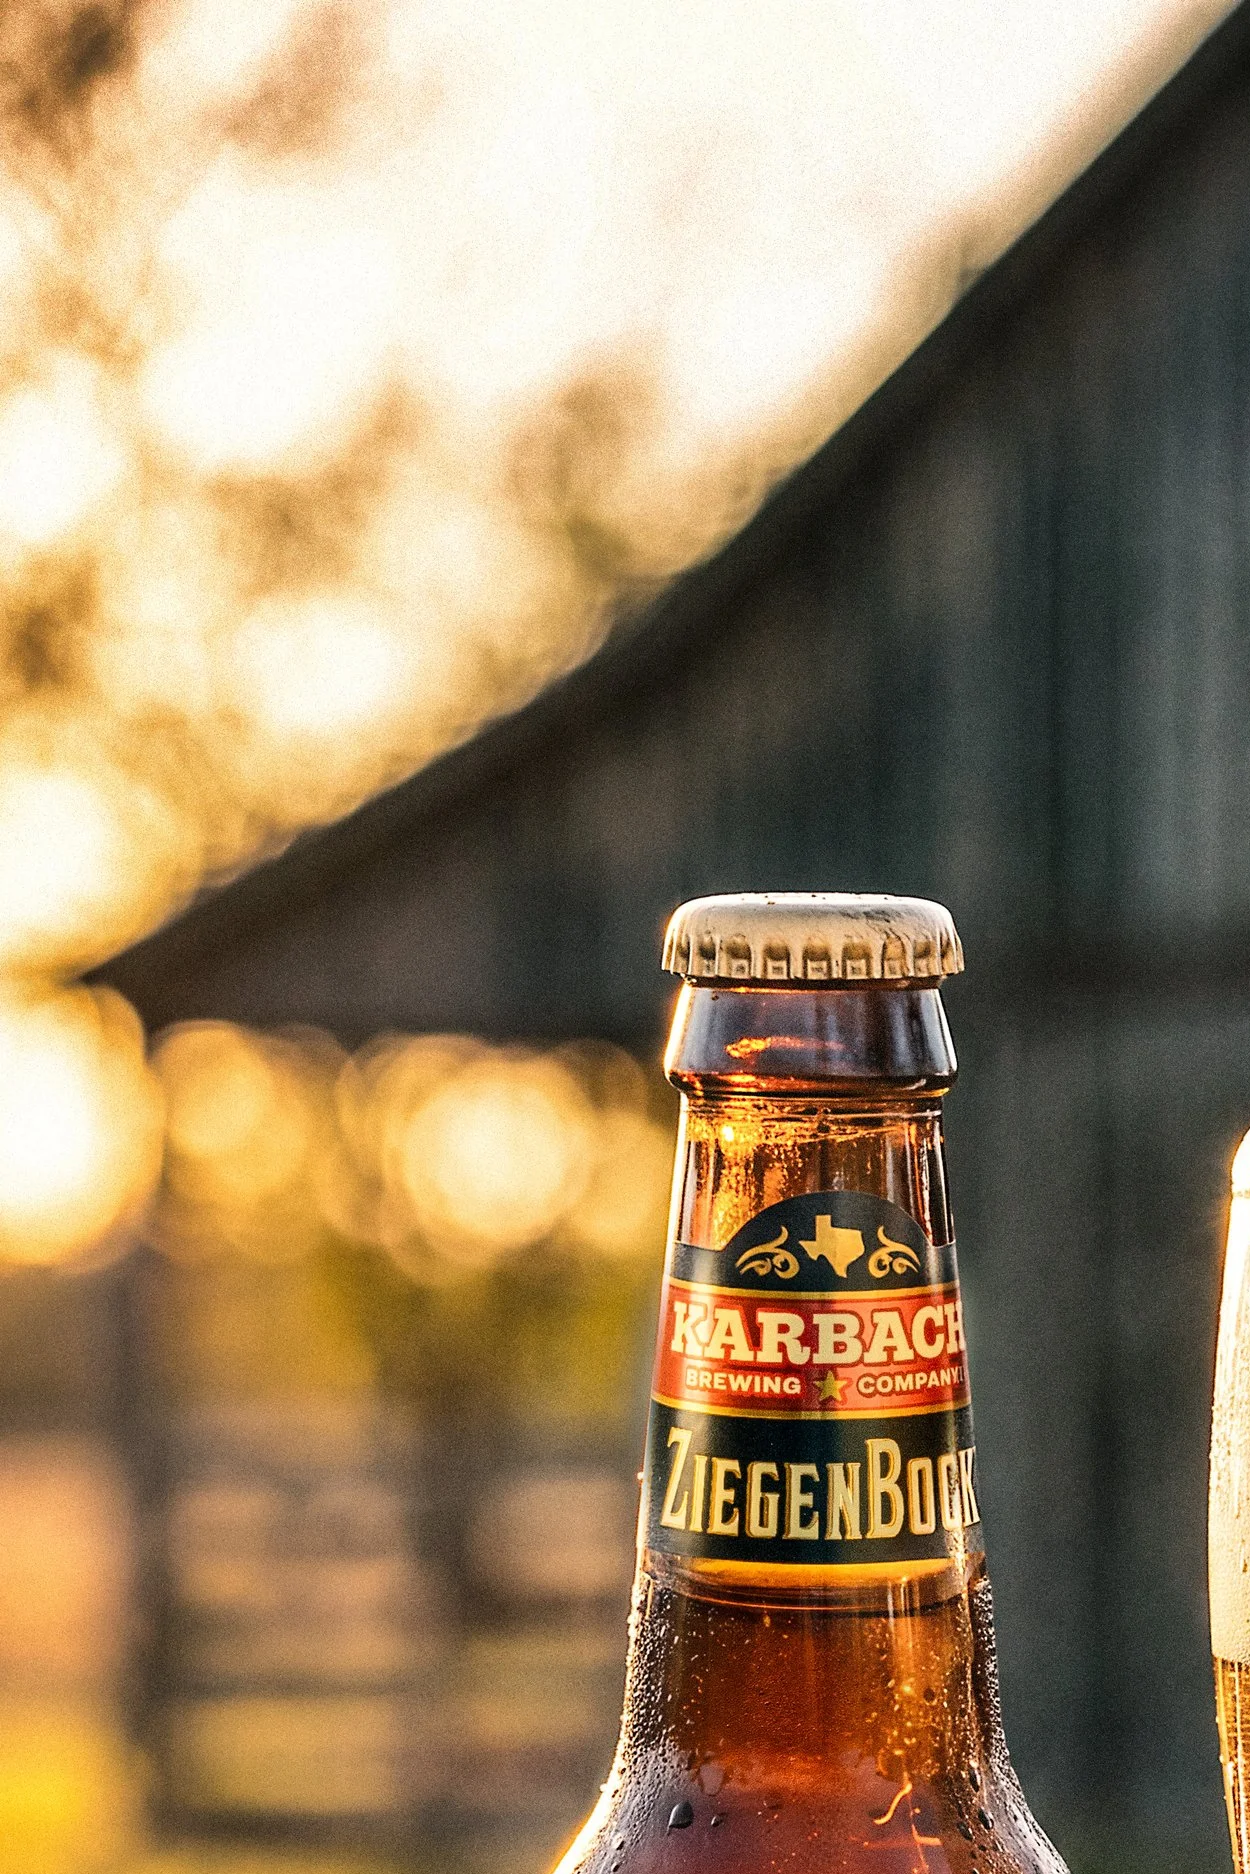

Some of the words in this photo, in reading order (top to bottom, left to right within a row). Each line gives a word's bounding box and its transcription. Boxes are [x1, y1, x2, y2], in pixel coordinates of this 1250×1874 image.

[671, 1300, 966, 1365] KARBACH
[686, 1368, 802, 1395] BREWING
[857, 1365, 960, 1395] COMPANY
